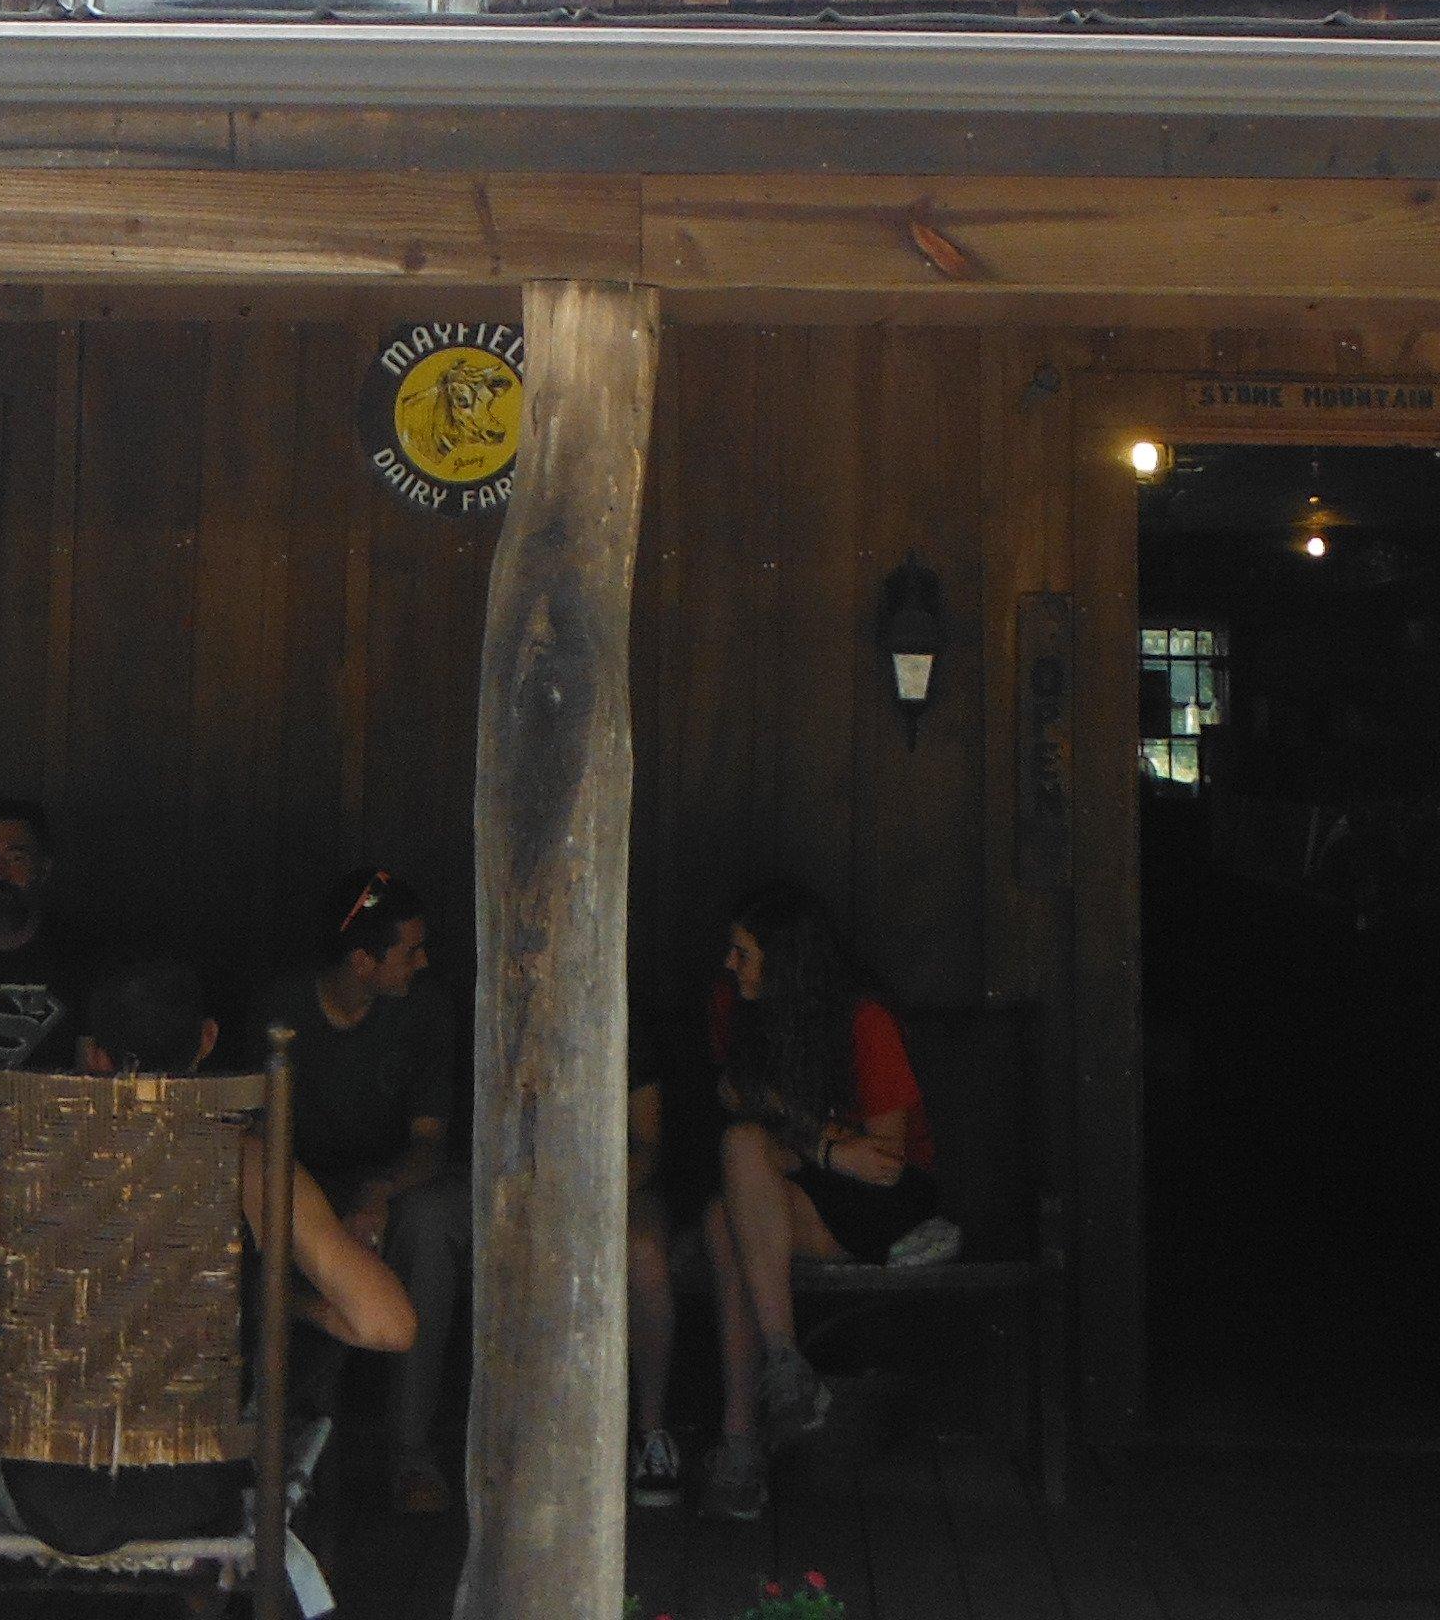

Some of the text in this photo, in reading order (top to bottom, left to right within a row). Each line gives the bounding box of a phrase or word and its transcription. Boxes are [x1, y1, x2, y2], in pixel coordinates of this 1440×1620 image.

[380, 322, 524, 376] MAYFIEL
[1198, 384, 1284, 408] STONE
[1302, 385, 1434, 409] MOUNTAIN
[372, 447, 516, 511] DAIRY FAR
